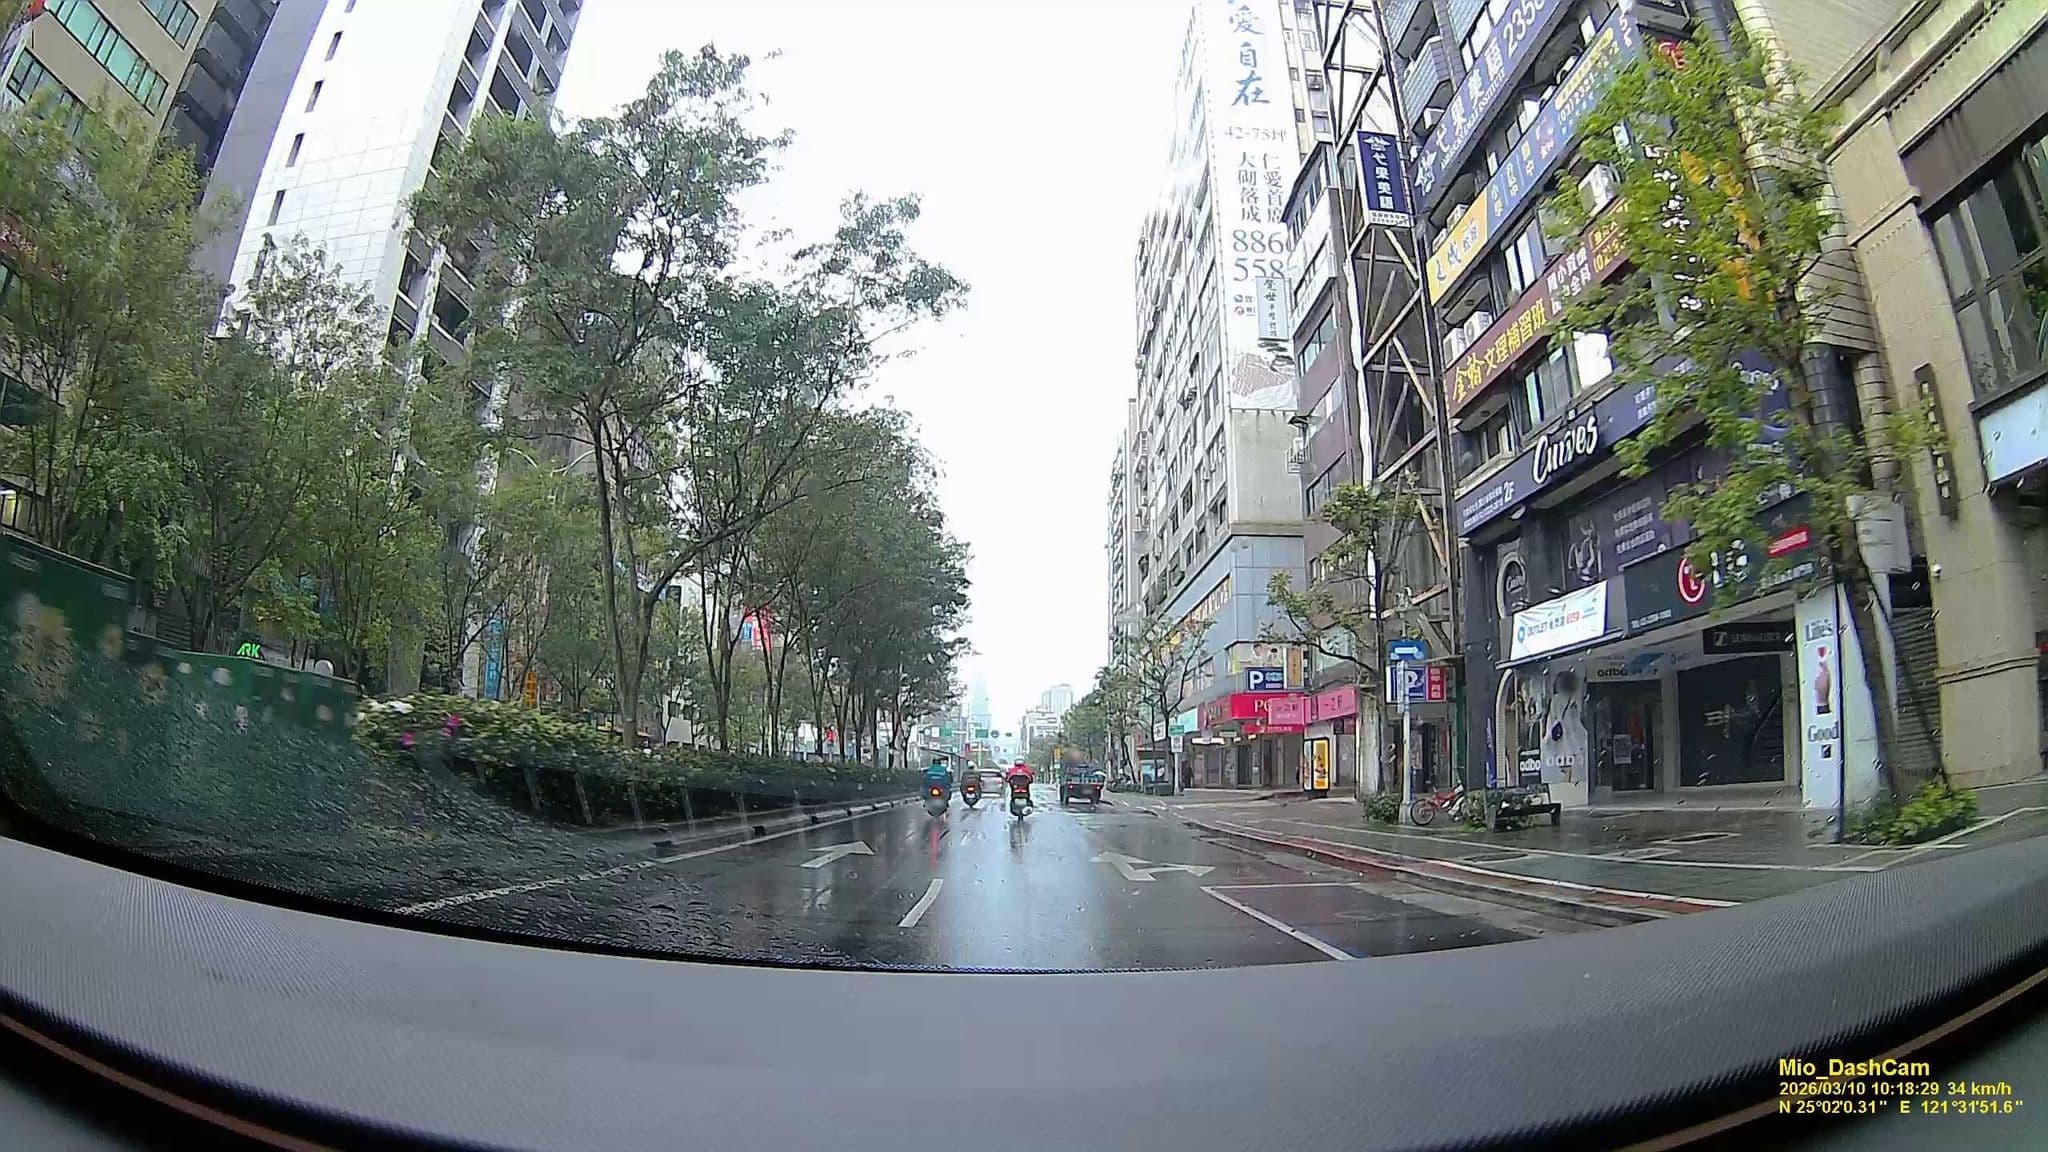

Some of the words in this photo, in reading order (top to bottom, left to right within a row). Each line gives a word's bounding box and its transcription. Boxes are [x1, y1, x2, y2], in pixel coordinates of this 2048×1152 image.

[1228, 0, 1271, 106] 愛自在
[1233, 229, 1292, 255] 886
[1533, 416, 1599, 484] Curves
[1250, 670, 1264, 689] P
[1808, 720, 1840, 742] Good
